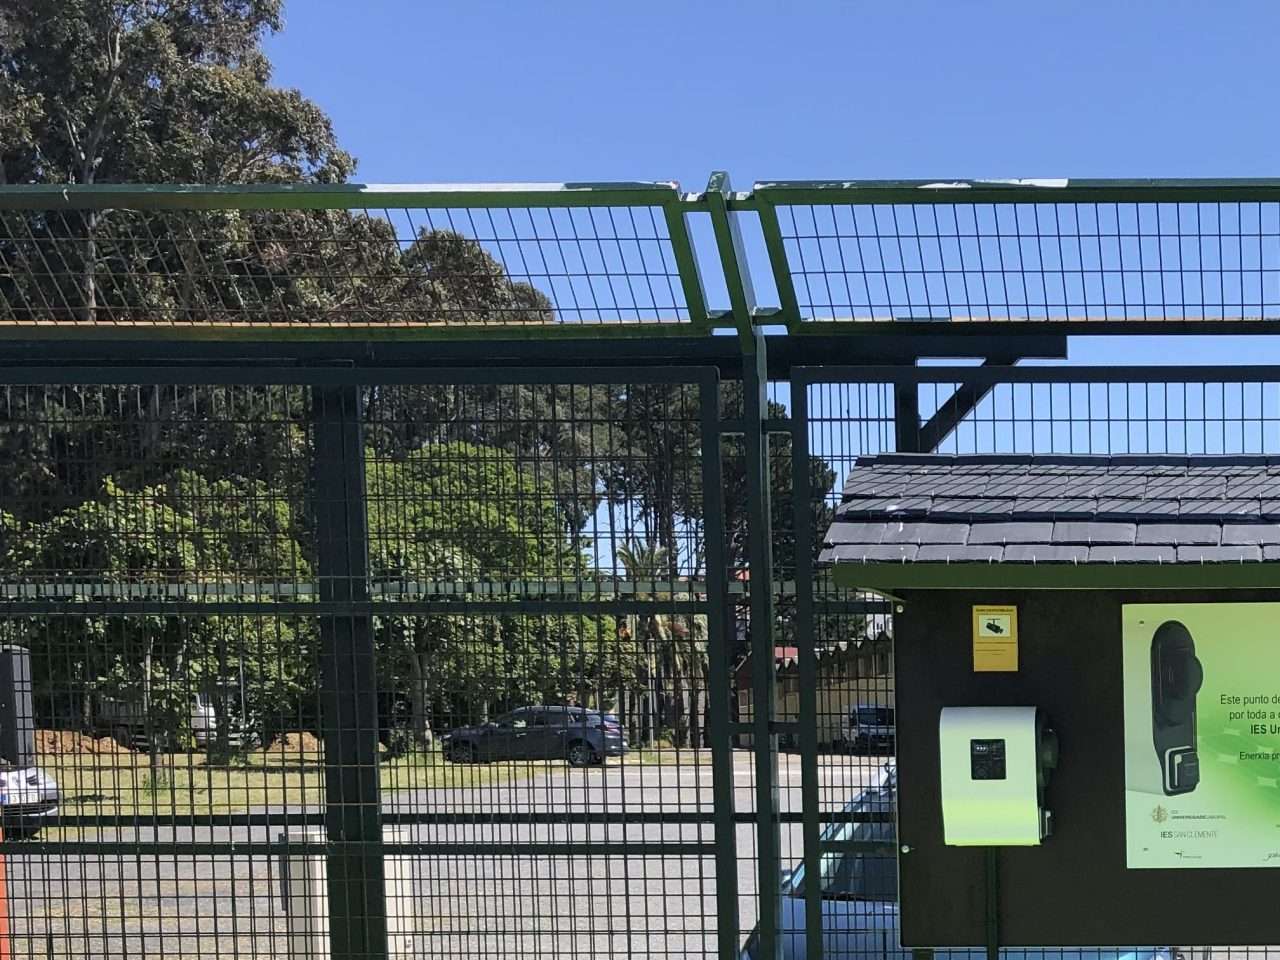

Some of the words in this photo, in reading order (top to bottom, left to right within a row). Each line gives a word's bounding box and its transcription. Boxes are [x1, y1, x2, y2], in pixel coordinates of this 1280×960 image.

[1220, 694, 1241, 705] Este
[1243, 695, 1269, 706] punto
[1229, 711, 1245, 720] por
[1247, 709, 1267, 719] toda
[1269, 711, 1276, 719] a
[1250, 724, 1267, 734] IES
[1160, 831, 1173, 839] IES
